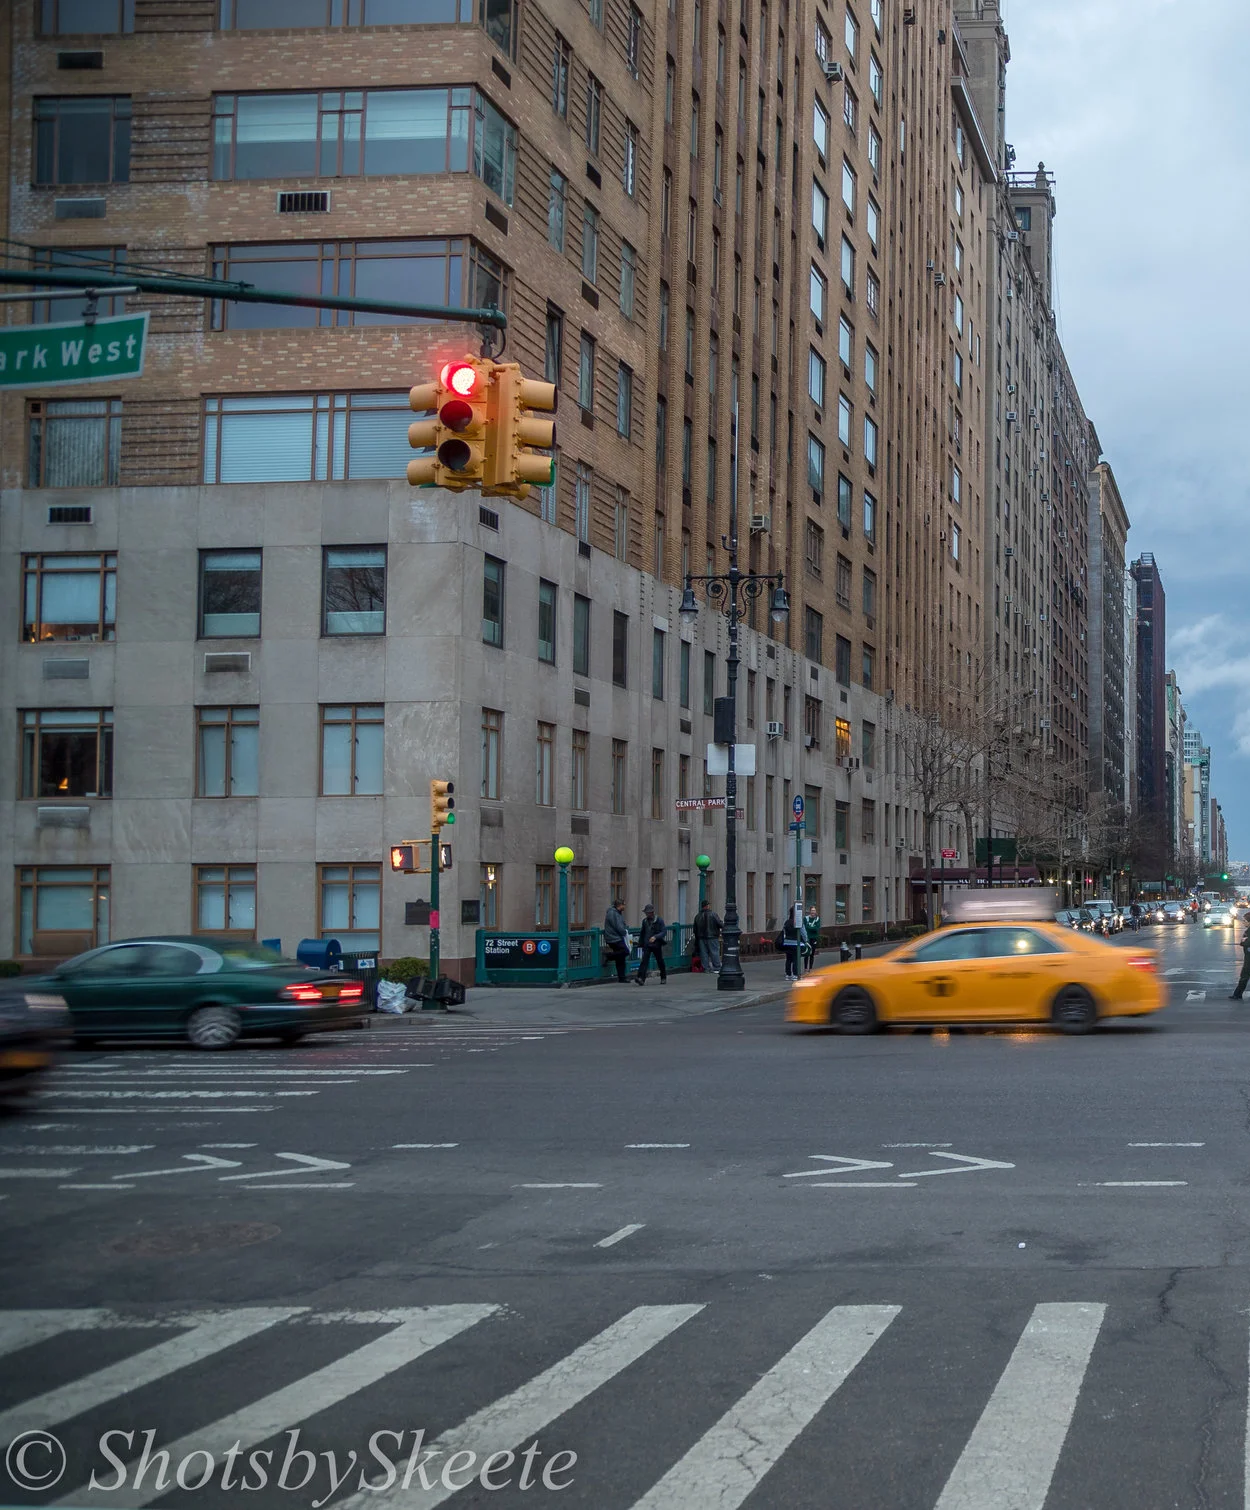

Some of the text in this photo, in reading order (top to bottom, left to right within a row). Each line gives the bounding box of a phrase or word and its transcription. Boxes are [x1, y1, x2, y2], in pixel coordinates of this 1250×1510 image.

[0, 333, 137, 371] ark West
[675, 798, 726, 808] CENTRAL PARK
